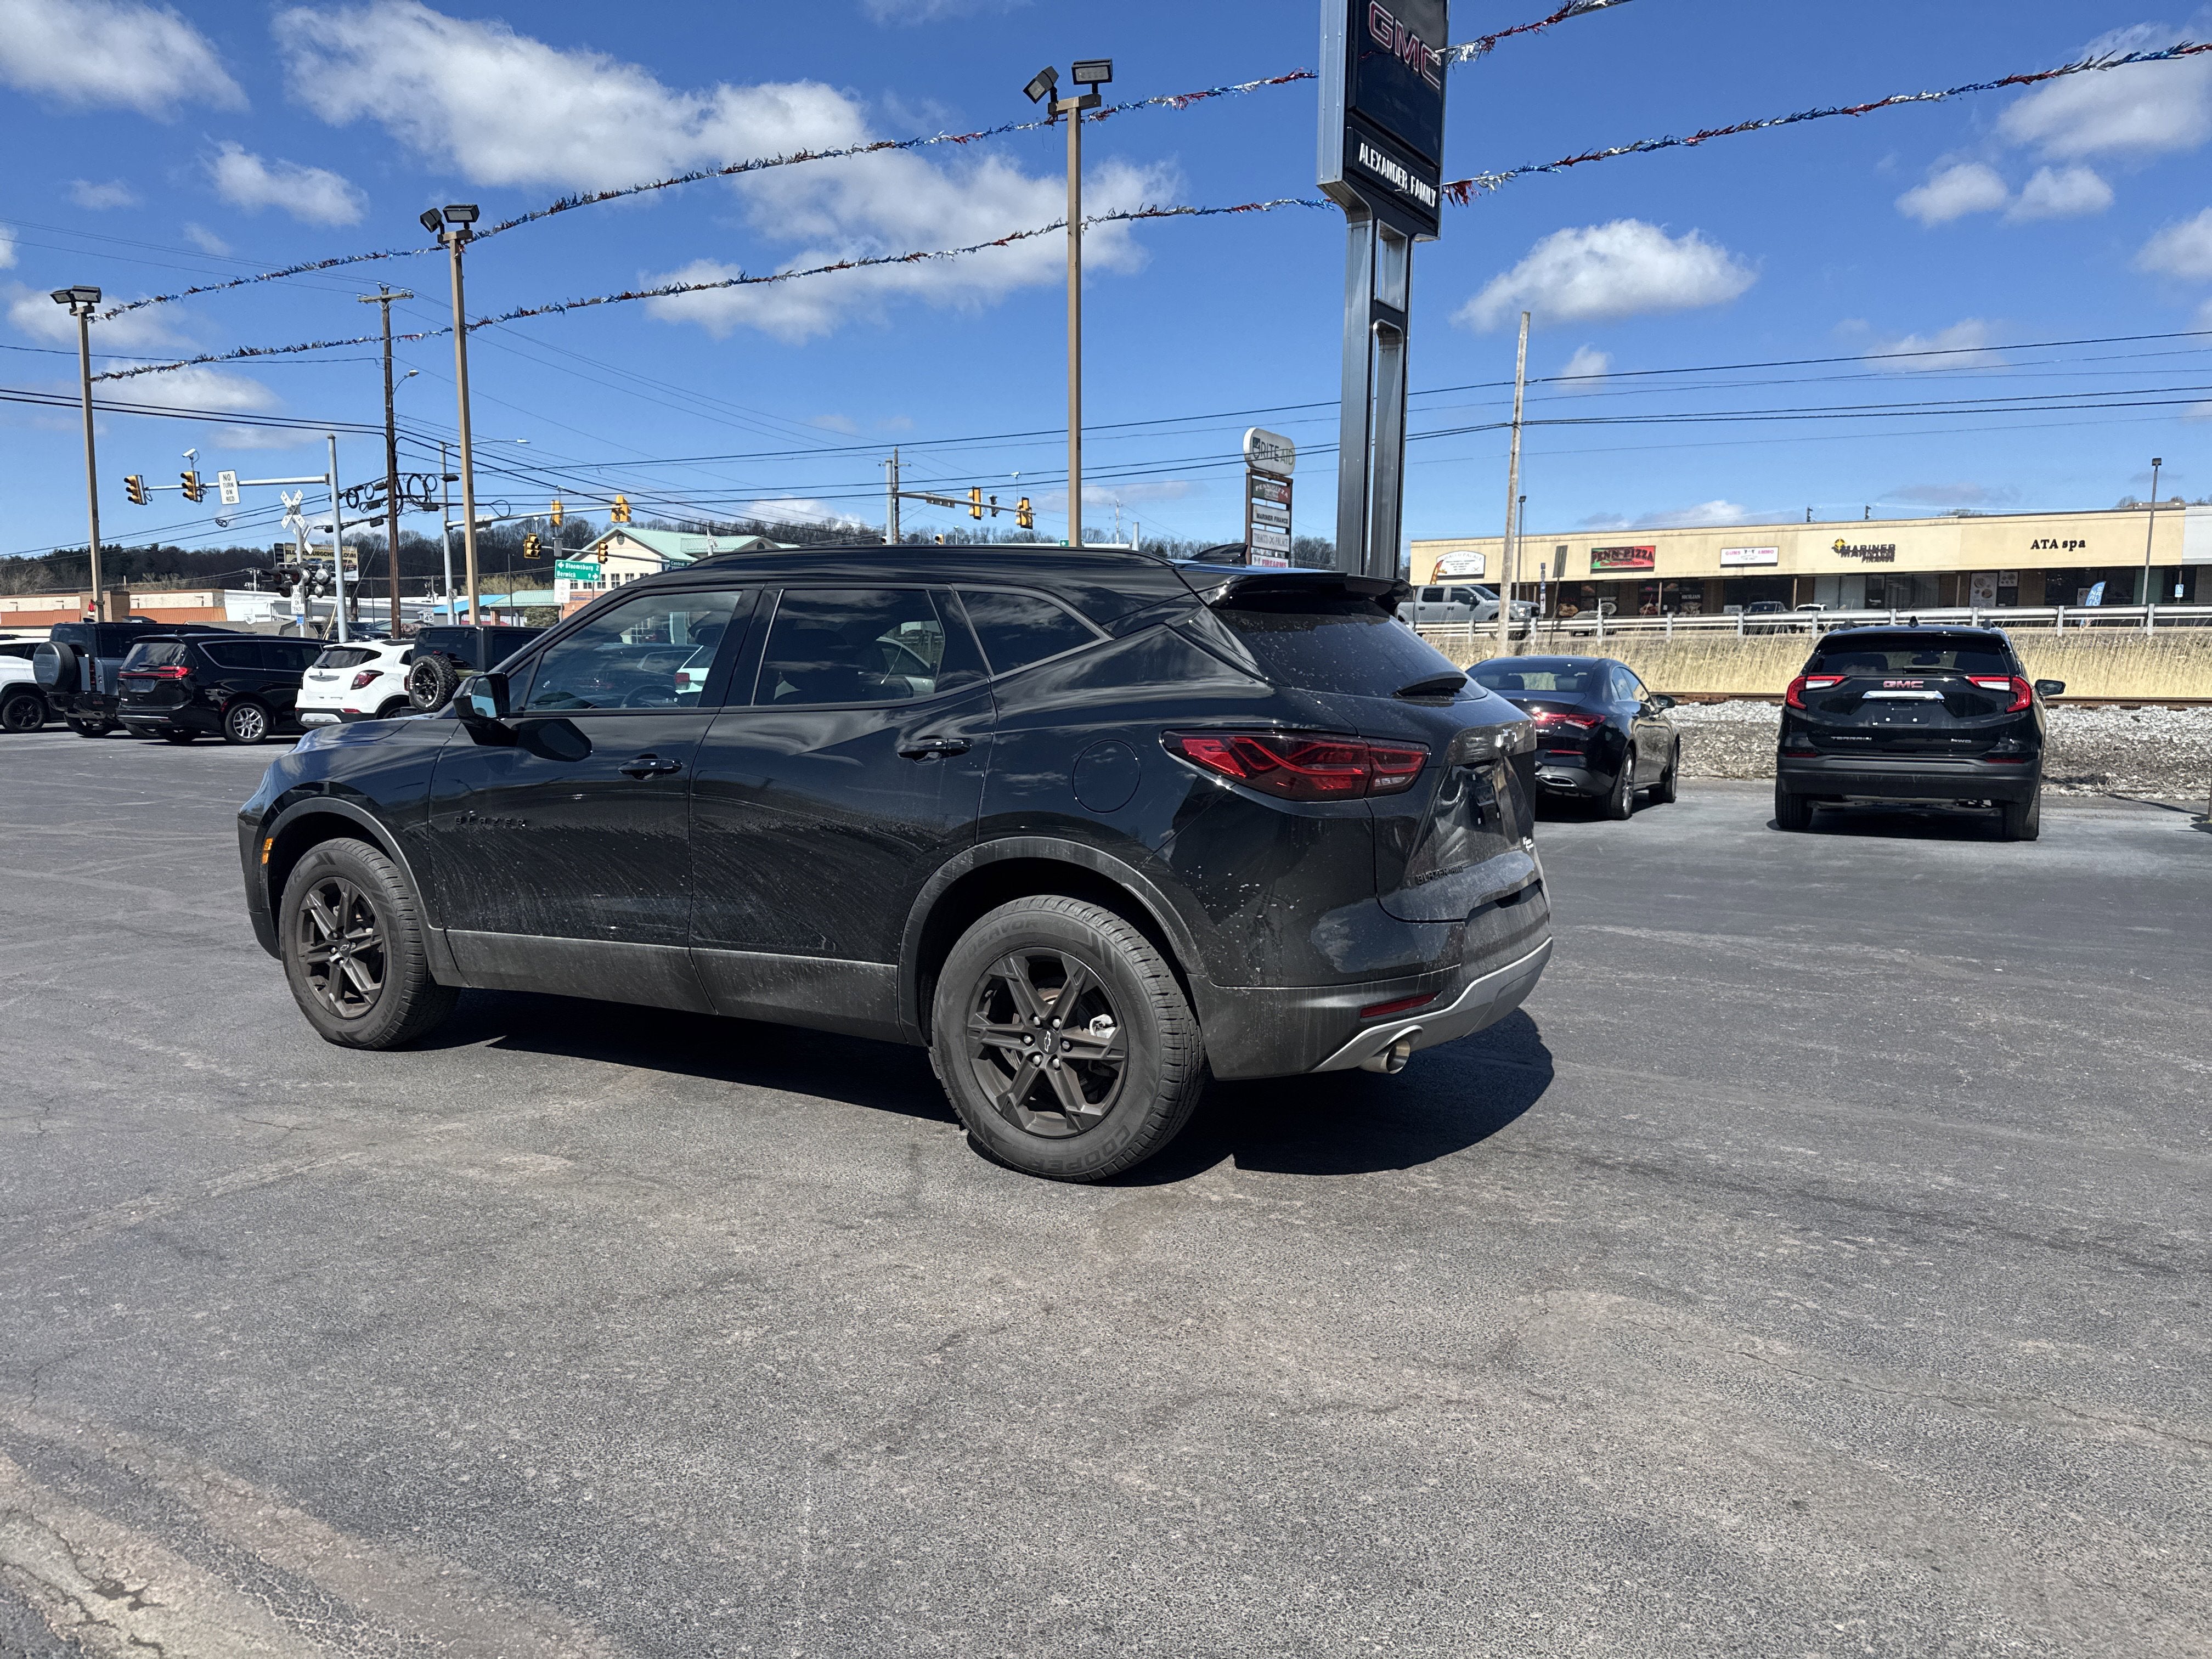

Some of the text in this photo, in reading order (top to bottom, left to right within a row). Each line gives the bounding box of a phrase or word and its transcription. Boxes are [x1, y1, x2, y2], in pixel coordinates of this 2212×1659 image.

[1369, 2, 1441, 90] GMC
[1358, 142, 1437, 208] ALEXANDER FAMILY
[1260, 441, 1295, 466] RITE AID
[1839, 544, 1896, 555] MARINER
[2030, 539, 2086, 552] ATA spa
[1590, 550, 1619, 564] PENN
[1623, 548, 1654, 562] PIZZA
[565, 562, 594, 572] Bloomsburg
[2092, 586, 2103, 606] SALO
[1883, 680, 1925, 689] GMC
[1027, 1125, 1131, 1172] COOPER
